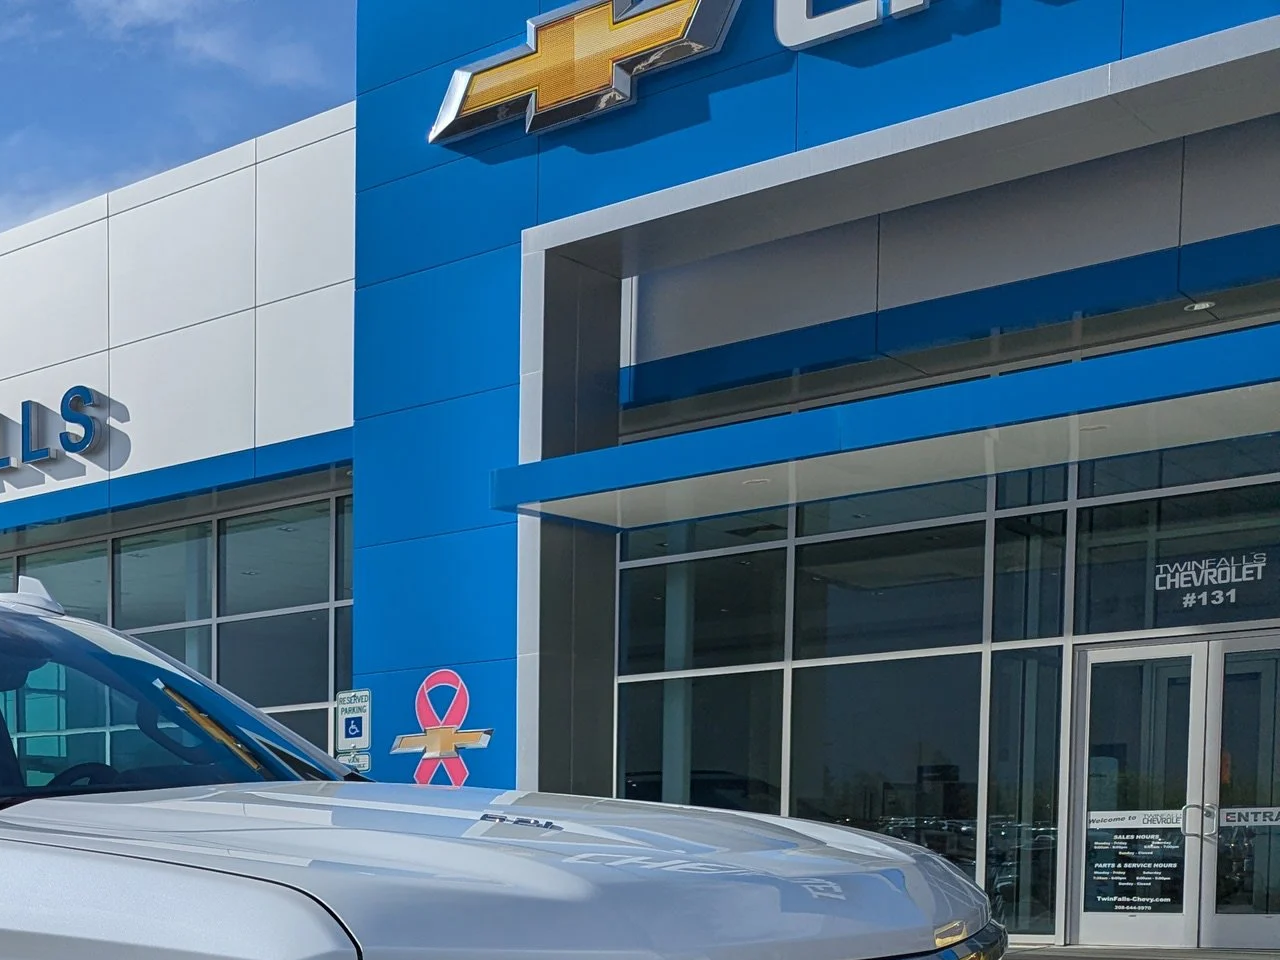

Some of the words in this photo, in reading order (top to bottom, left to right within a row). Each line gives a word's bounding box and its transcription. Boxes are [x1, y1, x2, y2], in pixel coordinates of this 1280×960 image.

[1155, 563, 1267, 591] CHEVROLET
[1182, 588, 1236, 608] #131
[339, 694, 369, 705] RESERVED
[340, 706, 367, 715] PARKING
[1088, 816, 1126, 825] Welcome
[1142, 817, 1182, 825] CHEVROLE
